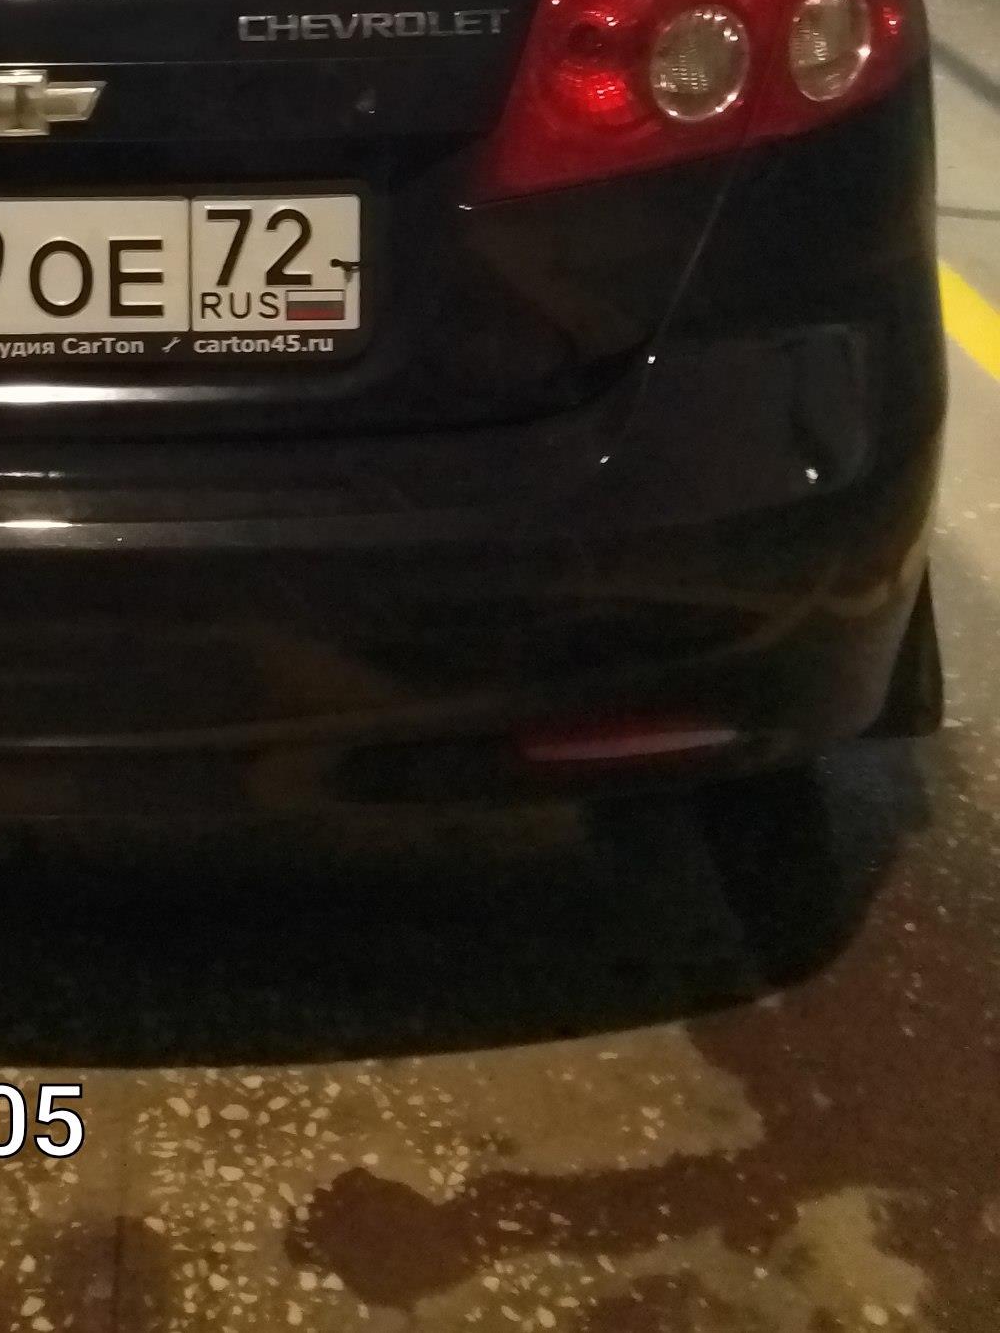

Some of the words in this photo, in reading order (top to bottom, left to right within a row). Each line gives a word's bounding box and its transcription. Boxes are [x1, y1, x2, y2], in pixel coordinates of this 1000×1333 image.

[238, 8, 510, 42] CHEVROLET
[205, 207, 314, 286] 72
[201, 292, 279, 320] RUS
[61, 337, 145, 355] CarTon
[193, 334, 335, 354] carton45.ru
